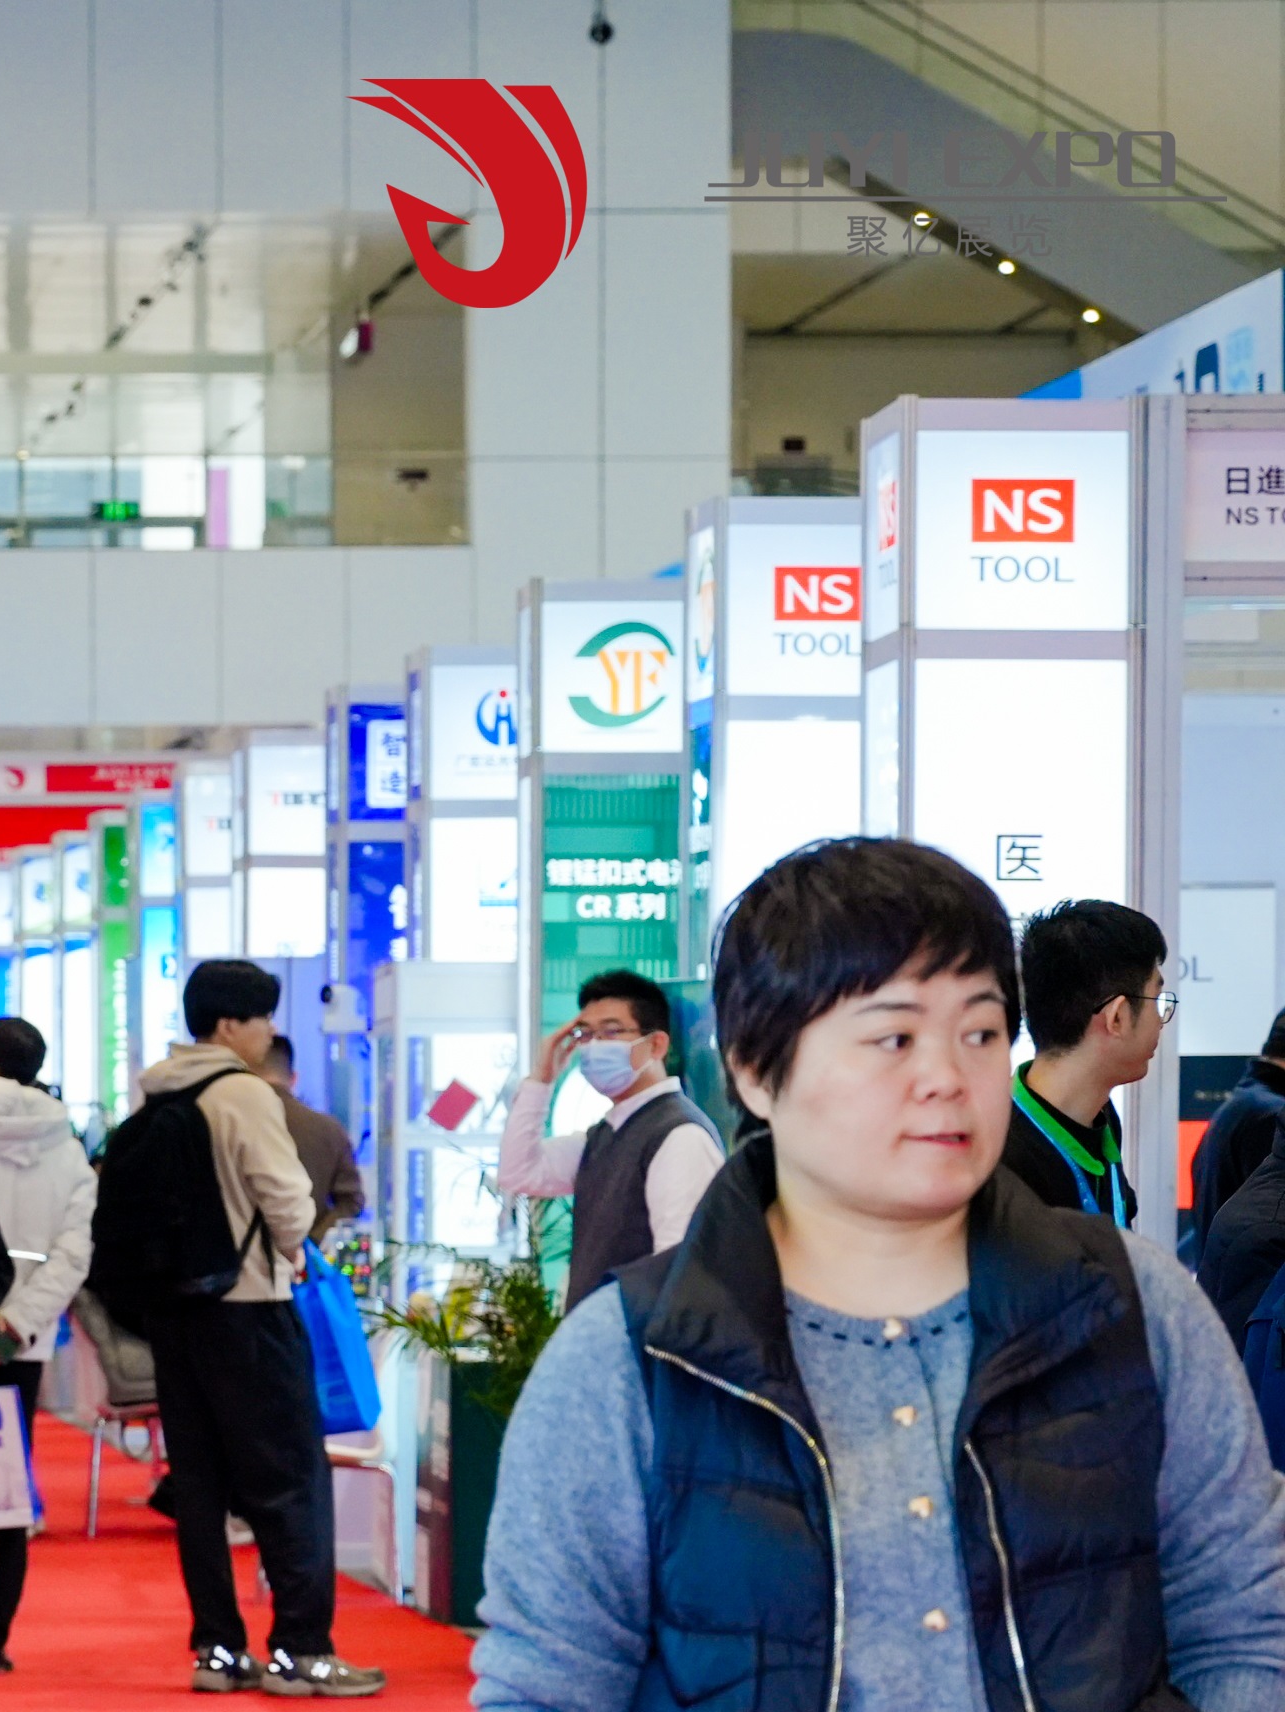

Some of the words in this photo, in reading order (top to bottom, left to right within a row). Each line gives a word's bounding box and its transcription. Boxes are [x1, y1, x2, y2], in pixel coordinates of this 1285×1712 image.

[984, 489, 1065, 534] NS
[1226, 507, 1259, 525] NS
[1266, 507, 1285, 525] T
[971, 556, 1076, 583] TOOL
[783, 575, 854, 615] NS
[774, 632, 860, 657] TOOL
[996, 835, 1044, 881] 医
[576, 894, 613, 919] CR
